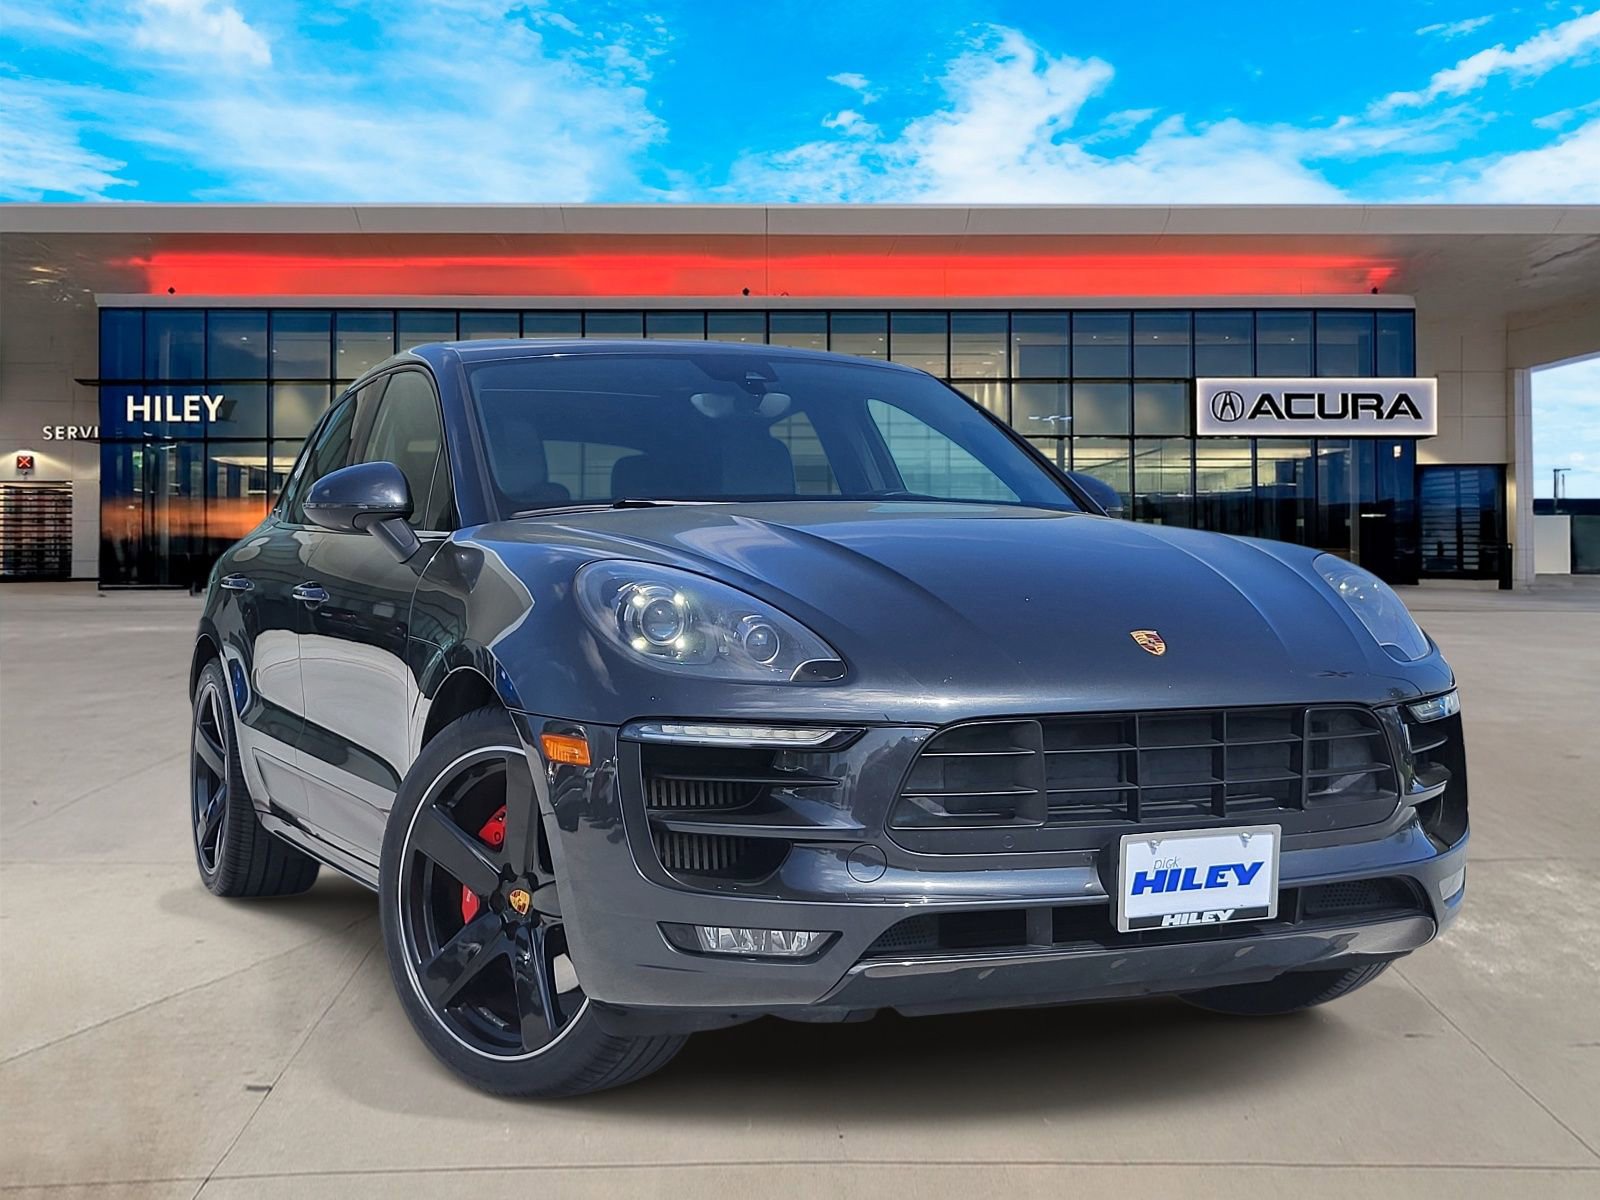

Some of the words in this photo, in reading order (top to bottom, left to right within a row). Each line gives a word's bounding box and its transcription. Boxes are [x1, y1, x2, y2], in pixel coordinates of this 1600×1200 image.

[126, 395, 224, 422] HILEY
[1247, 393, 1423, 420] ACURA
[42, 425, 99, 440] SERVI
[1153, 856, 1180, 870] pick
[1130, 861, 1265, 896] HILEY
[1161, 909, 1235, 927] HILEY
